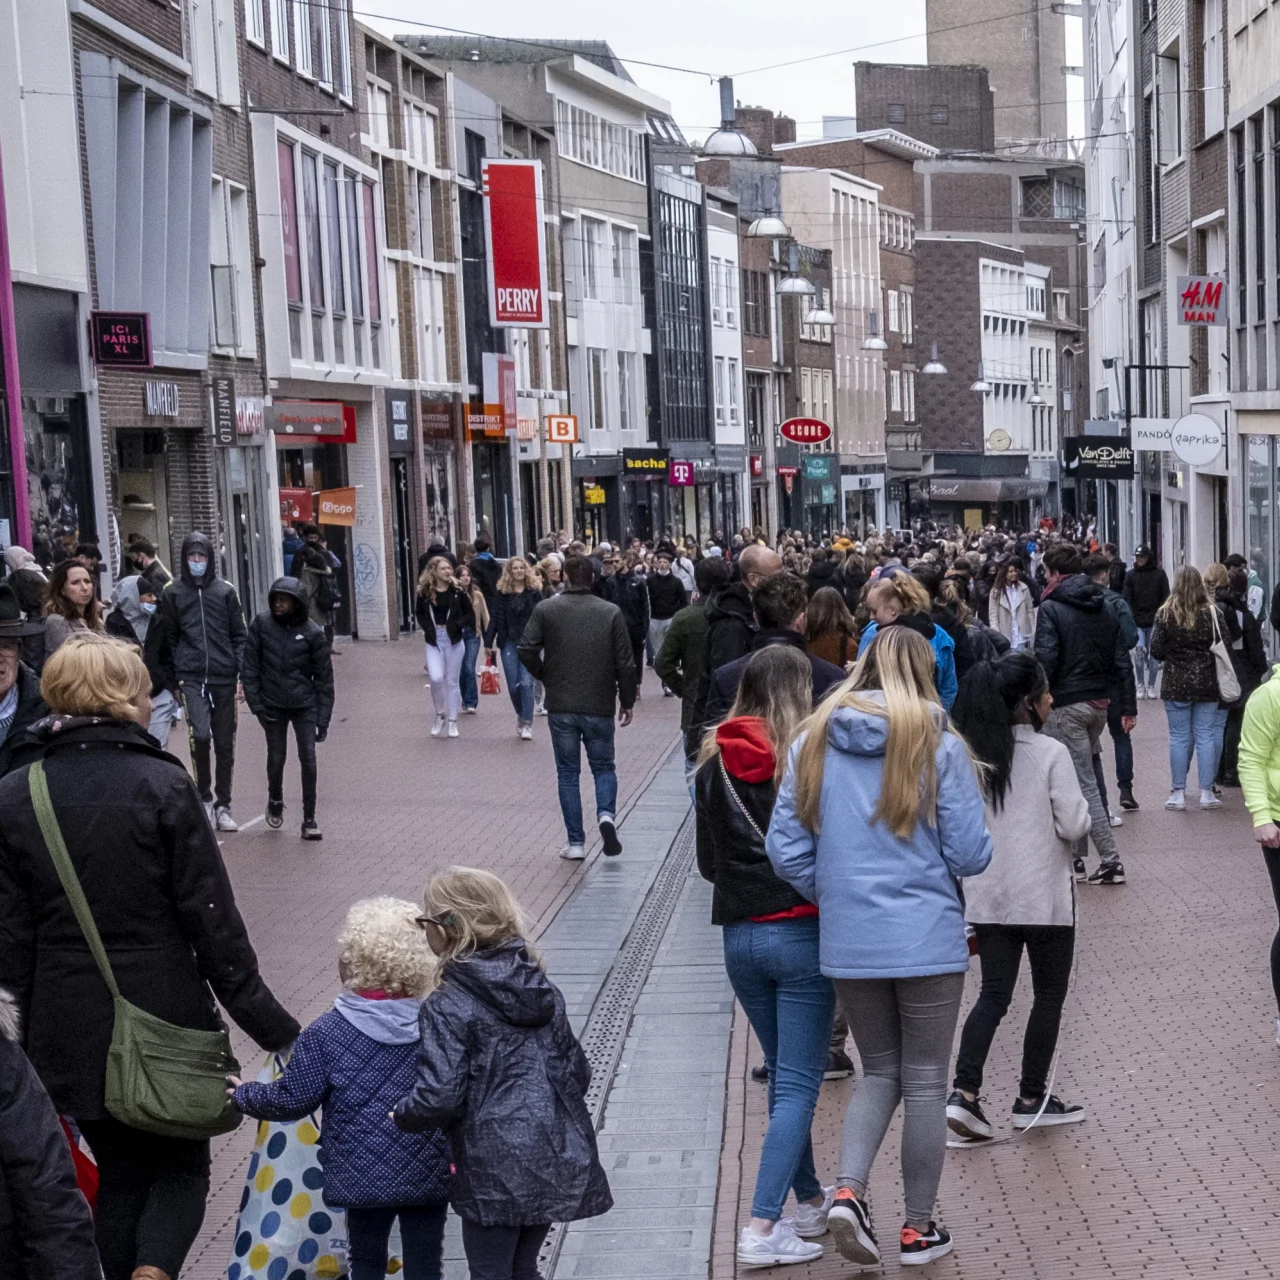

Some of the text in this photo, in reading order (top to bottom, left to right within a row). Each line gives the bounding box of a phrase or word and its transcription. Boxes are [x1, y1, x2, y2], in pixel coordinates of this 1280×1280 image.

[497, 287, 539, 313] PERRY
[1181, 280, 1223, 309] H&M
[1184, 311, 1215, 323] MAN
[111, 324, 129, 334] ICI
[103, 334, 139, 344] PARIS
[114, 344, 129, 354] XL
[217, 380, 232, 443] MANFIELD
[556, 421, 570, 436] B
[790, 425, 822, 437] SCORE
[1137, 430, 1172, 439] PANDO
[1175, 432, 1220, 446] paprika
[674, 465, 689, 482] T
